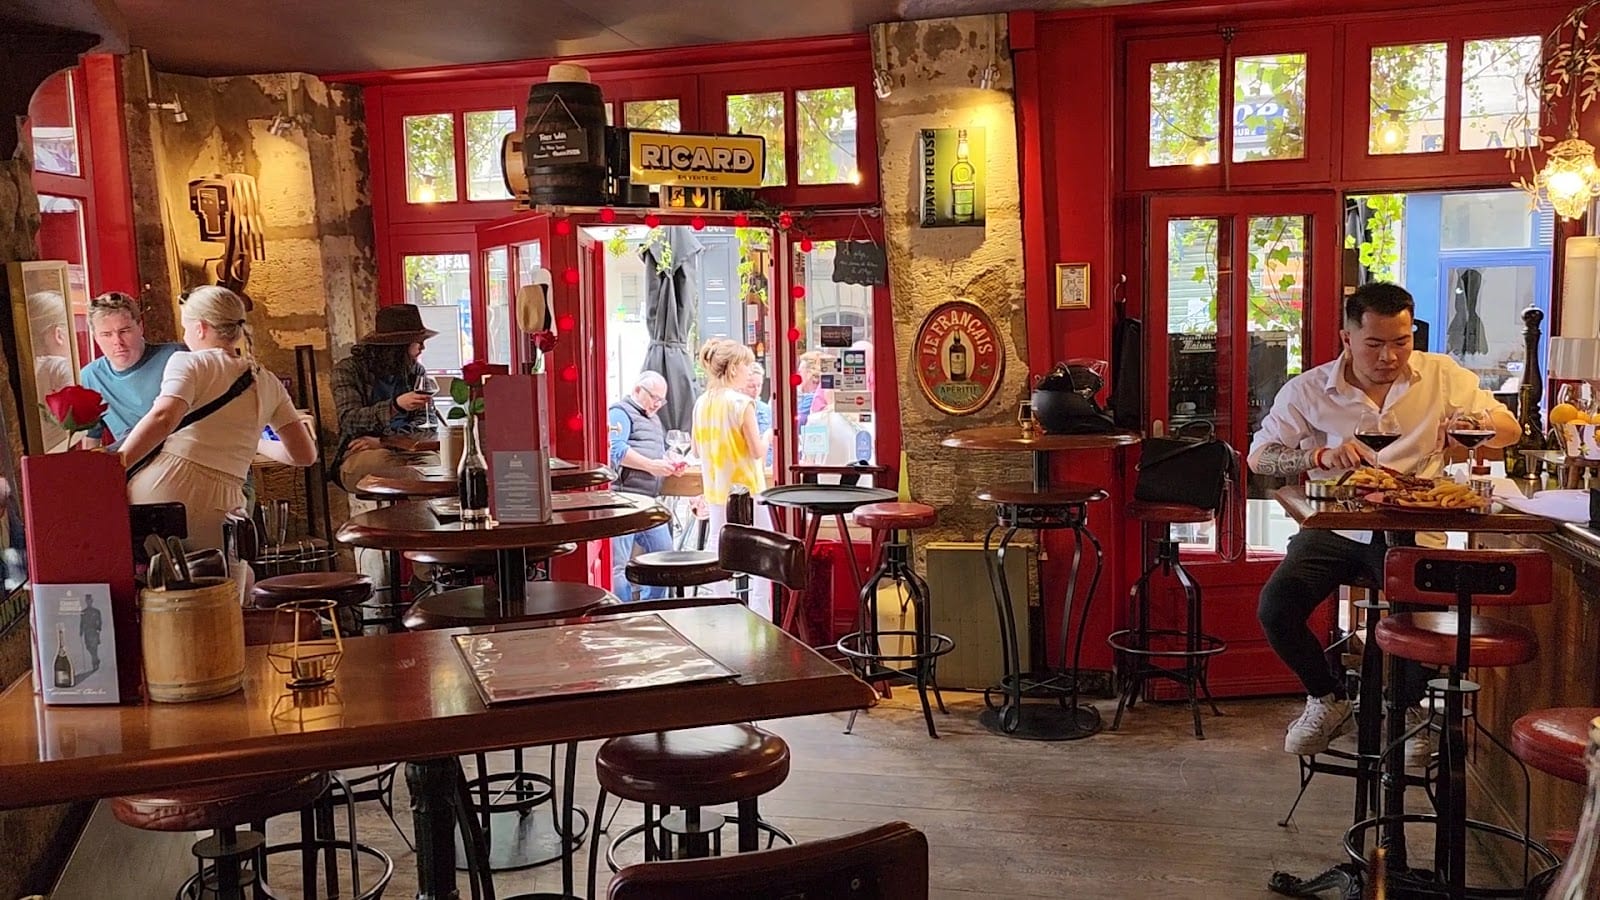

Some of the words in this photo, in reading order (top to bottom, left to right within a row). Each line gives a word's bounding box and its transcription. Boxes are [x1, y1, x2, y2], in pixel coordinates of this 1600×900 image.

[640, 144, 754, 173] RICARD
[925, 130, 936, 225] CHARTREUSE
[923, 335, 940, 355] LE
[931, 310, 993, 355] FRANÇAIS
